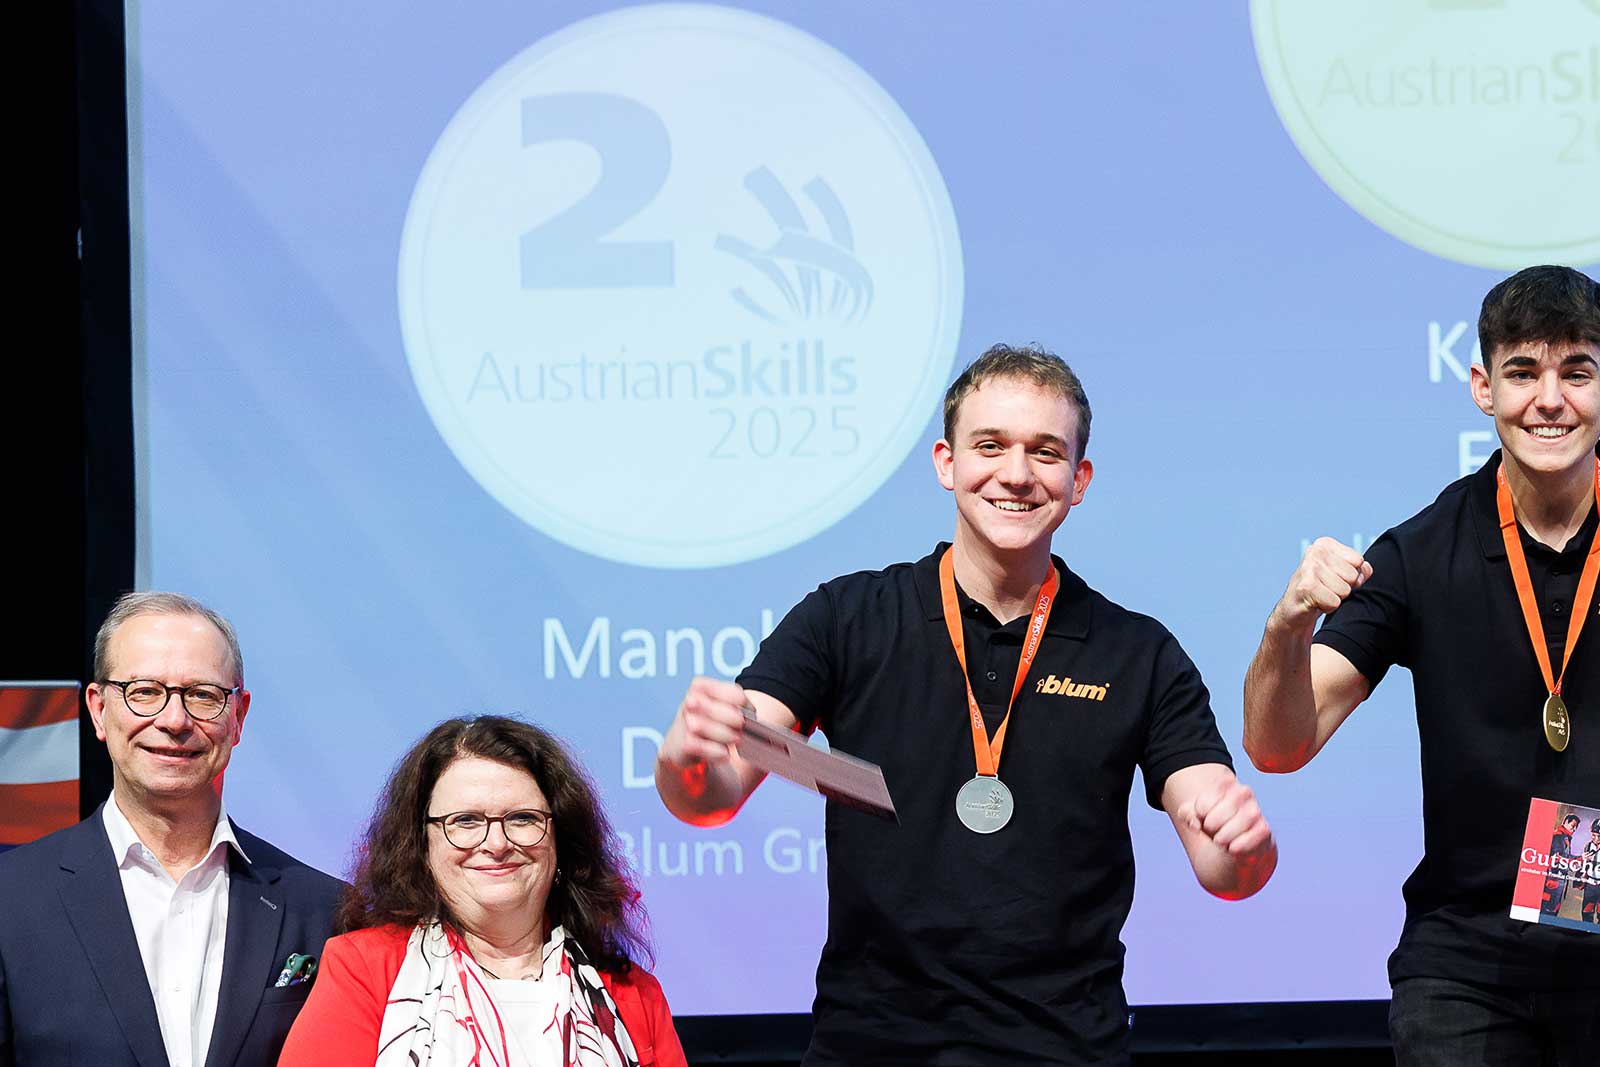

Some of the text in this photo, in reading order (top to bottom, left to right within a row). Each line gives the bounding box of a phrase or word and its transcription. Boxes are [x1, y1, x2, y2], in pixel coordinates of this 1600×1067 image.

[520, 90, 676, 291] 2
[465, 338, 858, 405] AustrianSkills
[707, 407, 861, 461] 2025
[1042, 675, 1108, 701] blum
